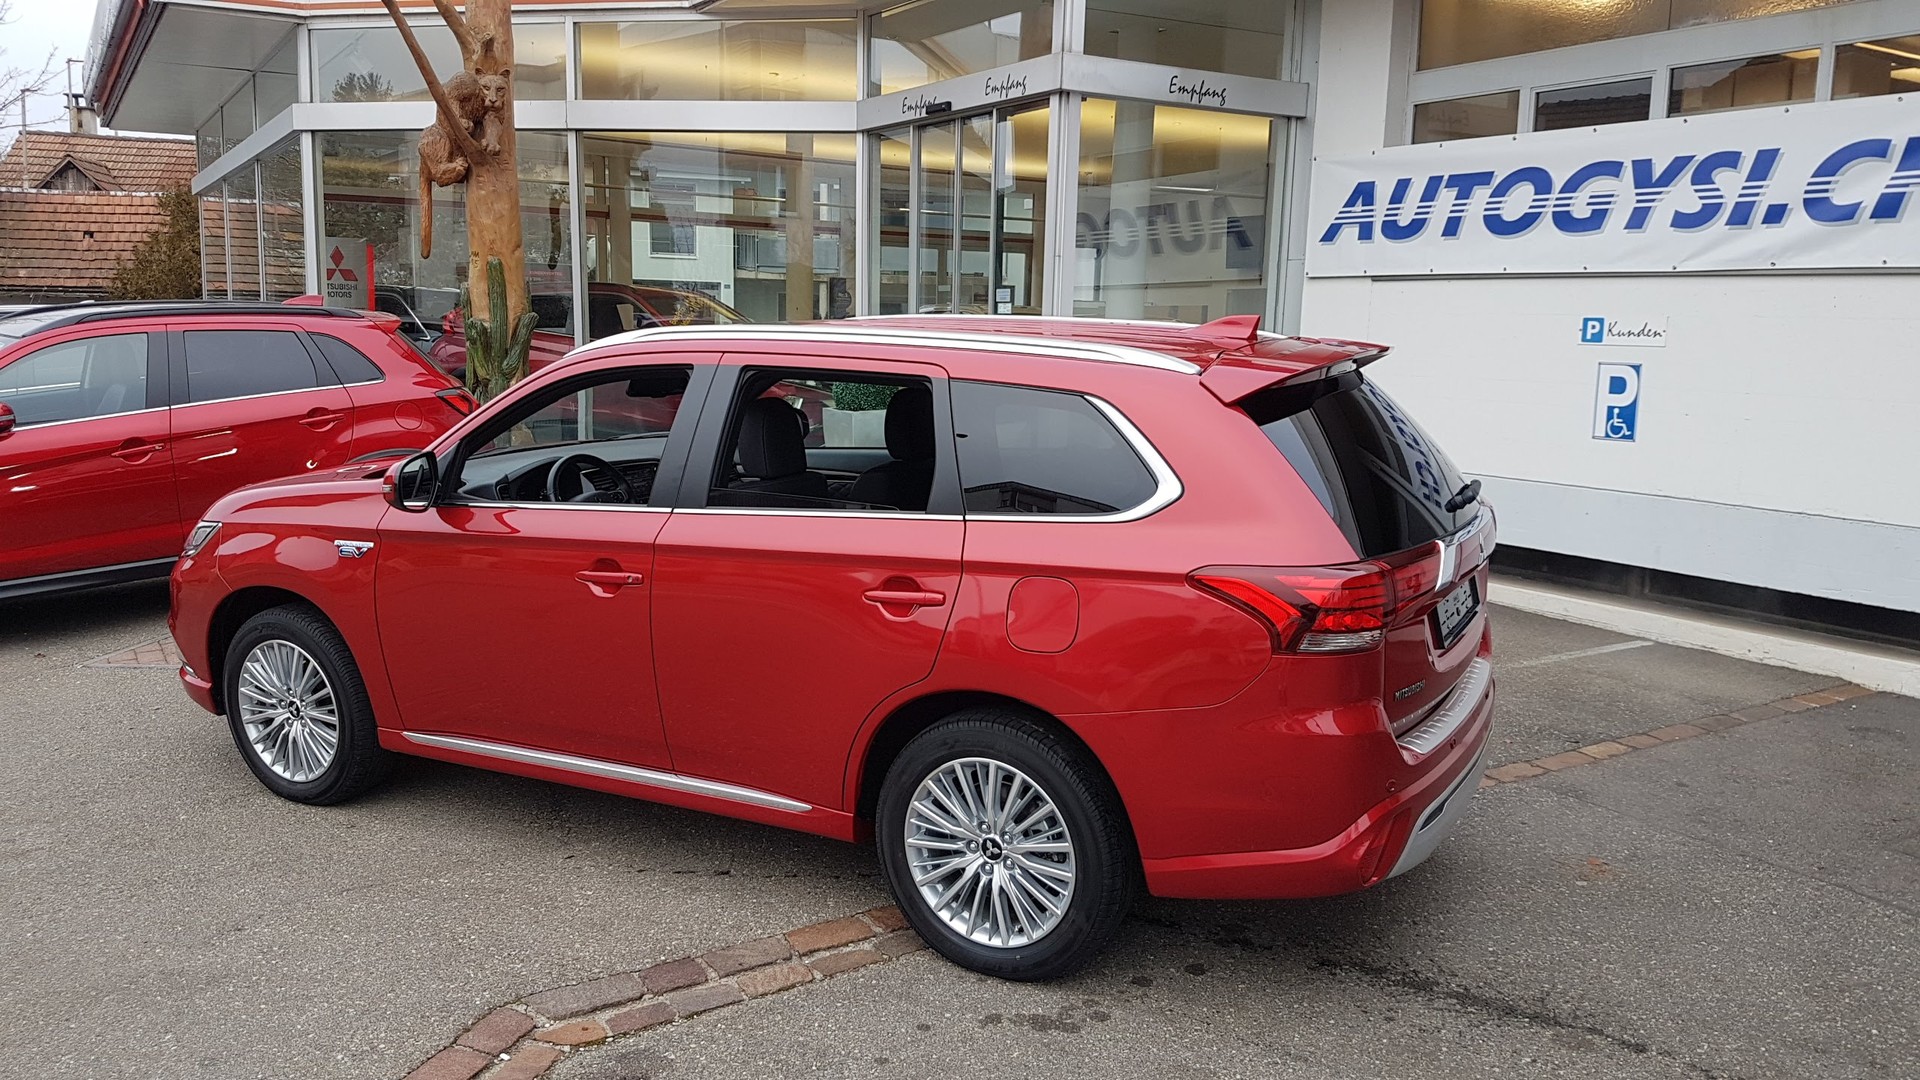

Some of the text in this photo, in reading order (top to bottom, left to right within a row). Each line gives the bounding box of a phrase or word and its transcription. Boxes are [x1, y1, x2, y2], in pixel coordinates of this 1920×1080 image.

[985, 73, 1027, 98] Empfang
[1168, 75, 1227, 107] Empfang
[1585, 320, 1664, 340] P Kunden
[1594, 364, 1638, 438] P
[338, 546, 368, 558] EV
